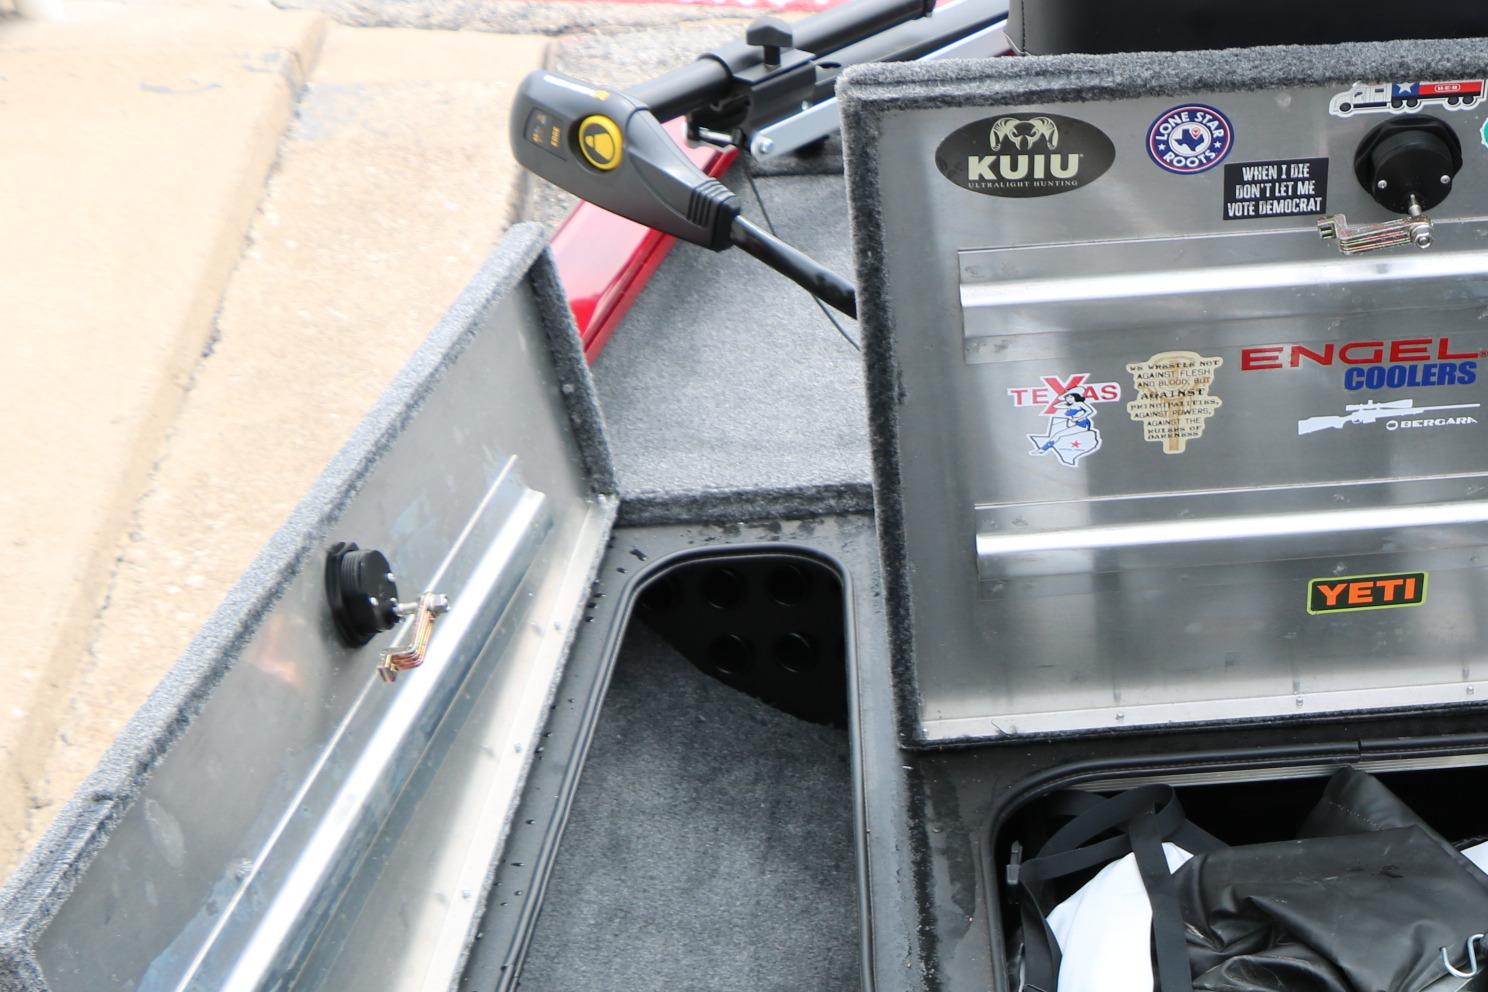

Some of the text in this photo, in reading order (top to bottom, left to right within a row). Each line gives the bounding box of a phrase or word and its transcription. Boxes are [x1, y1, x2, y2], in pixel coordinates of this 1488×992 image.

[1155, 111, 1225, 140] LONE STAR
[968, 153, 1079, 180] KUIU
[1163, 149, 1217, 168] ROOTS
[1242, 162, 1311, 181] WHEN I DIE
[1033, 179, 1079, 187] HUNTING
[1235, 179, 1316, 200] DON'T LET ME
[1227, 196, 1323, 217] VOTE DEMOCRAT
[1241, 337, 1479, 371] ENGEL
[1137, 368, 1211, 380] AGAINST FLESH
[1344, 361, 1478, 391] COOLERS
[1011, 375, 1118, 415] TEXAS
[1141, 388, 1206, 400] AGAINST
[1135, 410, 1169, 418] AGAINST
[1400, 416, 1478, 428] BERGARA
[1317, 577, 1417, 606] YETI
